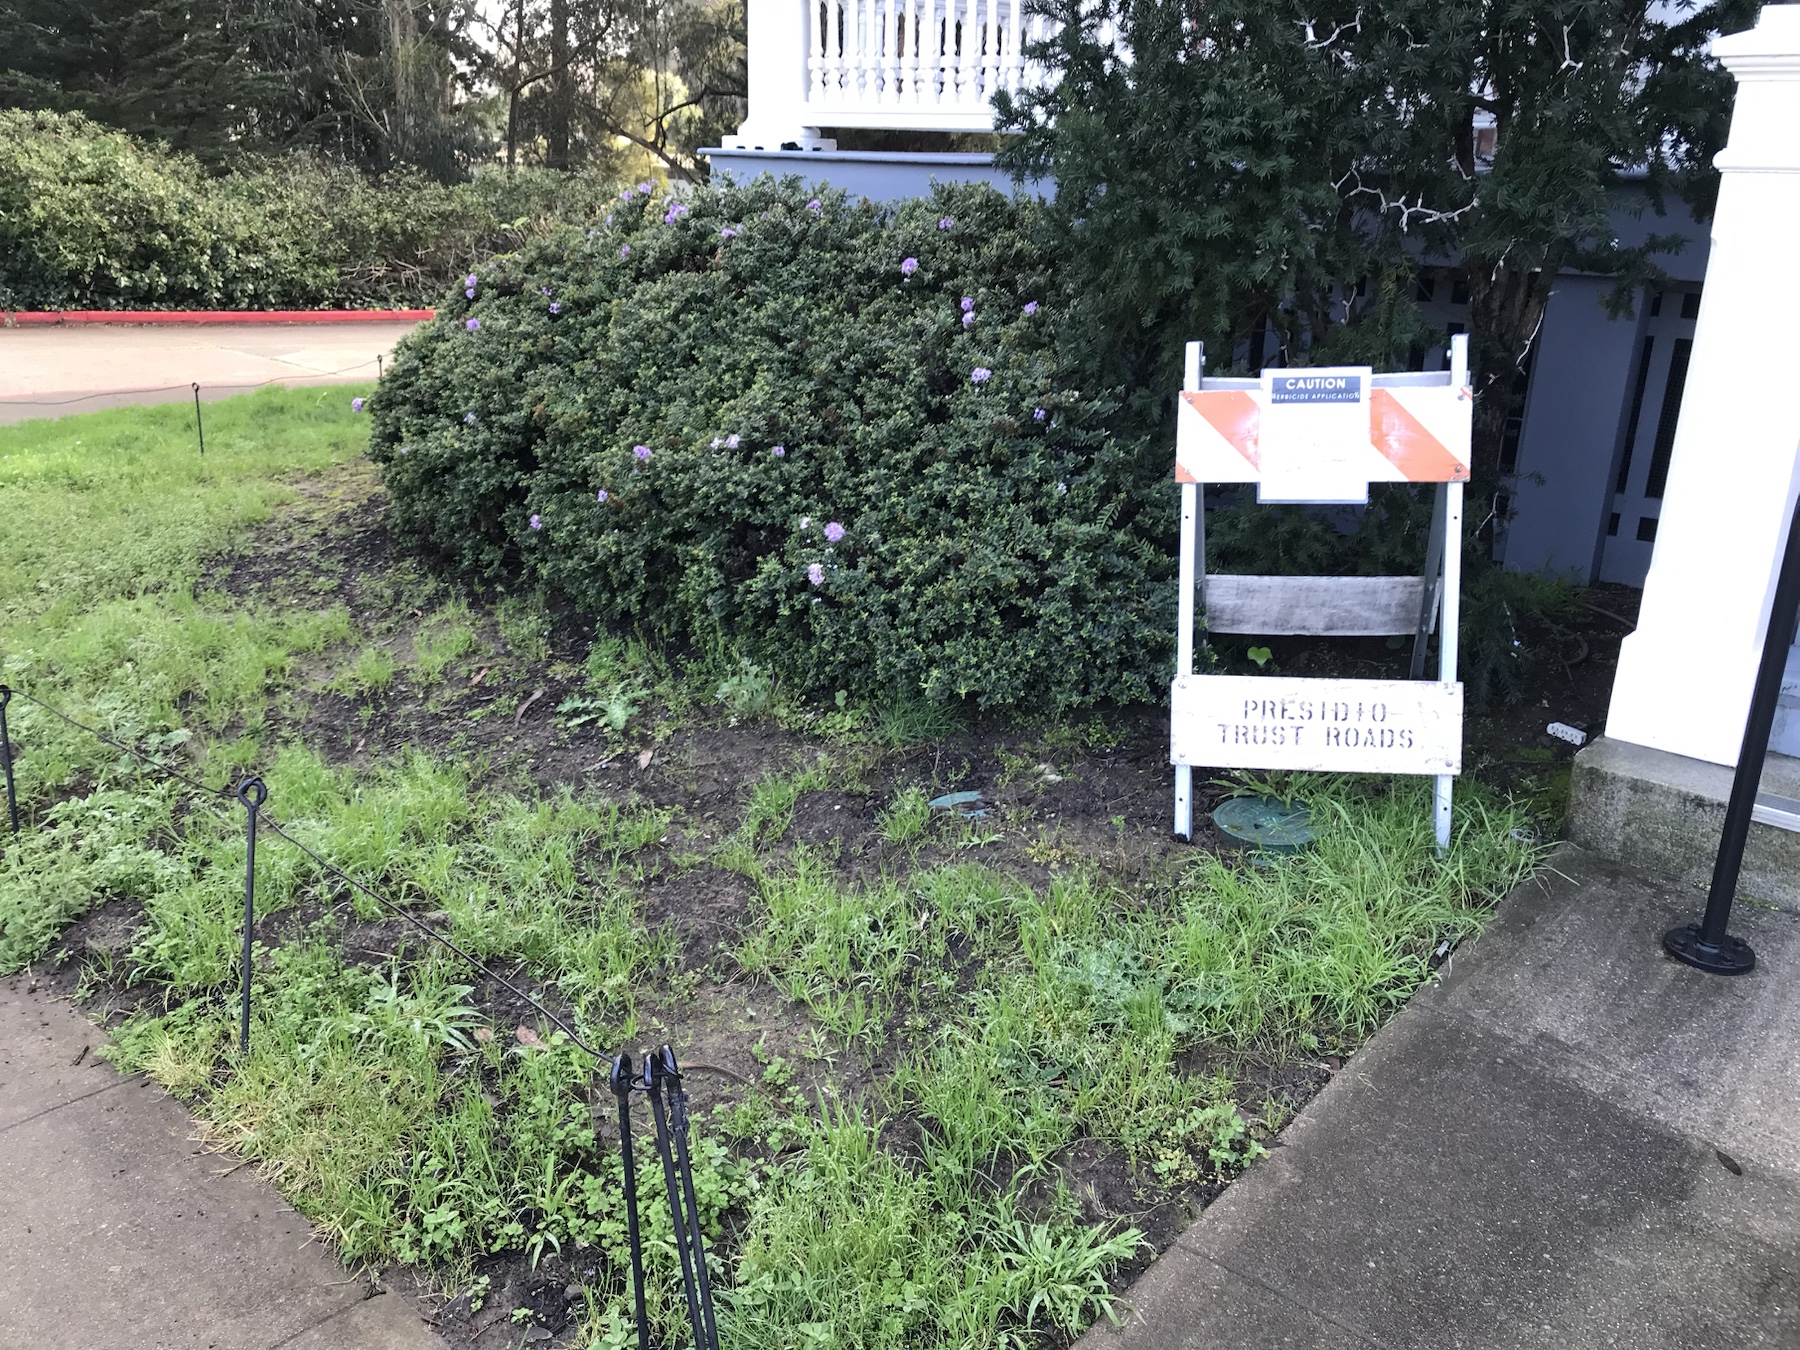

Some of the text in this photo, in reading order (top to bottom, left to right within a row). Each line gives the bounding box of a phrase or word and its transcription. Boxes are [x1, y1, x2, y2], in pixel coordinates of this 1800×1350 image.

[1286, 378, 1346, 389] CAUTION
[1244, 700, 1387, 722] PRESIDIO
[1217, 724, 1413, 748] TRUST ROADS
